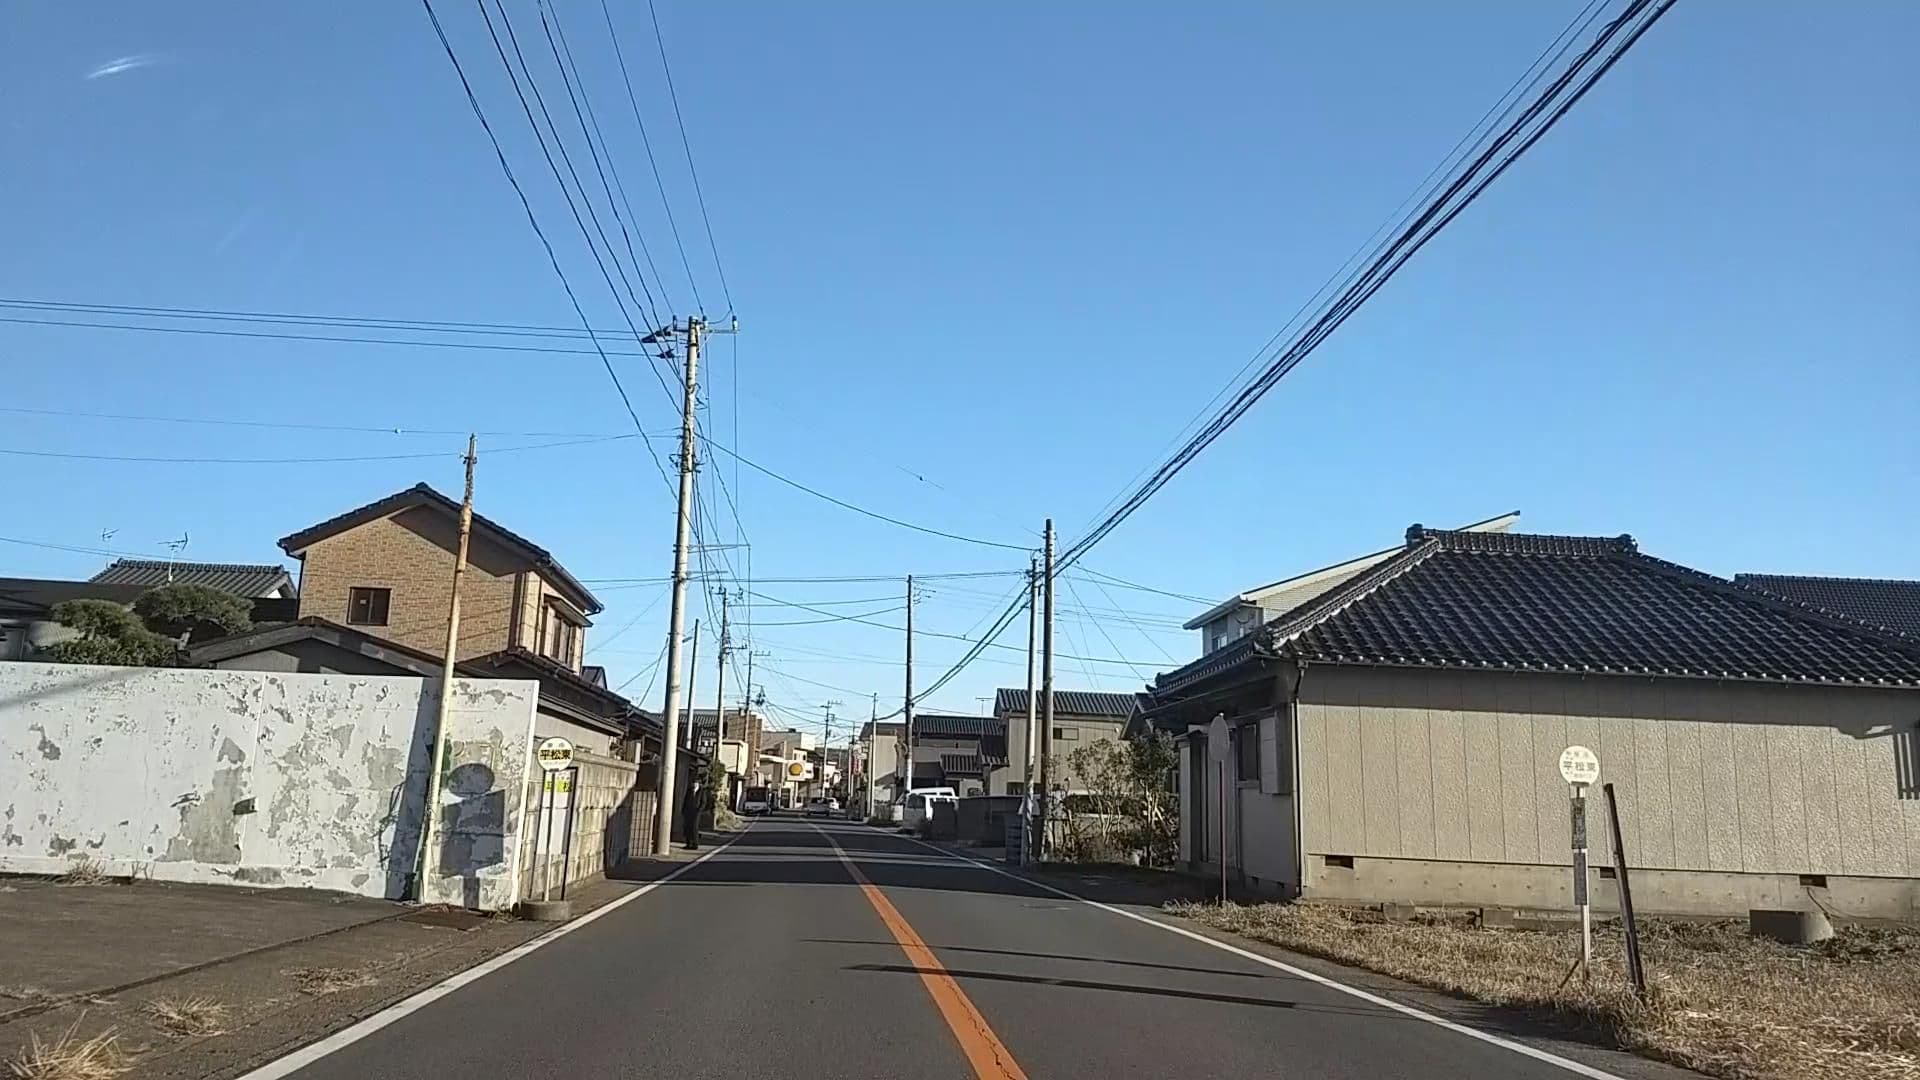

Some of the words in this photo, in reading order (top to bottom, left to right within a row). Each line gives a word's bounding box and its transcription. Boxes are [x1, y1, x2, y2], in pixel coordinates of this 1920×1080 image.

[540, 749, 571, 760] 平松東
[1563, 761, 1596, 772] 平松東
